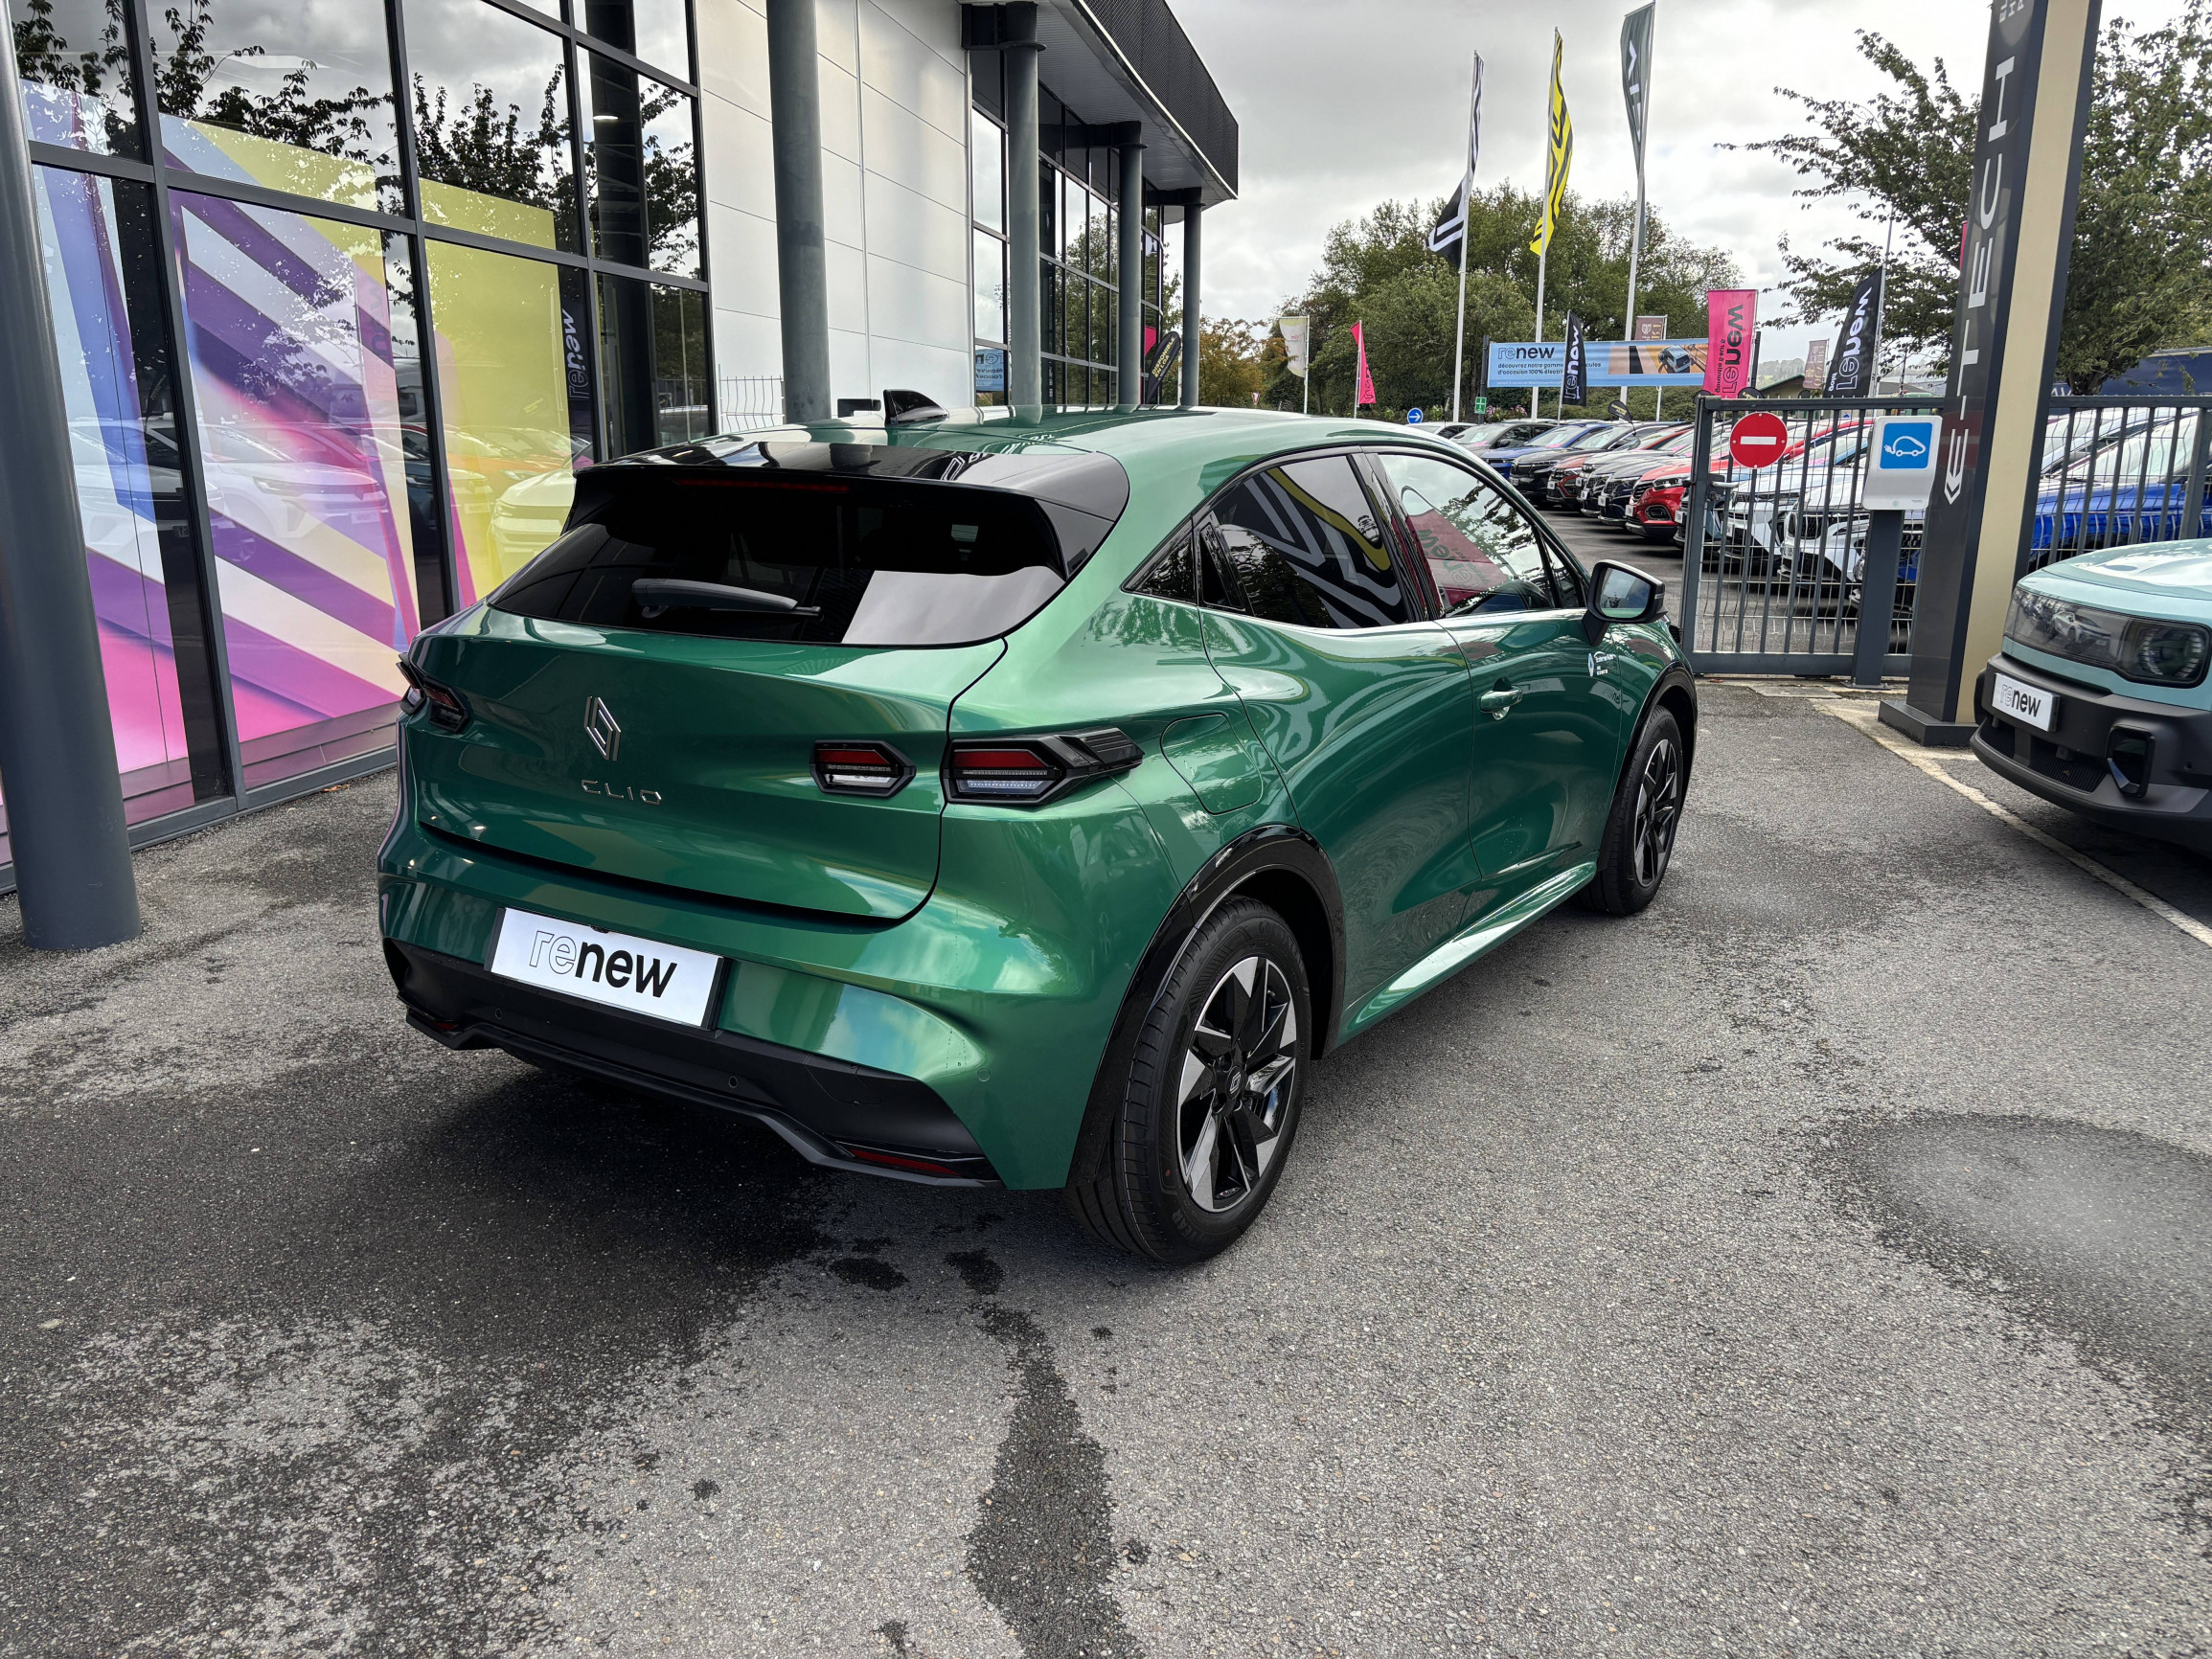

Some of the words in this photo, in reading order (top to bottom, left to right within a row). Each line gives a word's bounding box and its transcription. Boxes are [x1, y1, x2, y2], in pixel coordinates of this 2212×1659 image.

[561, 307, 590, 399] renew
[1152, 336, 1175, 375] DISPONIBLE
[1497, 347, 1555, 360] renew
[1563, 324, 1580, 399] renew
[1999, 683, 2041, 717] renew
[581, 778, 663, 806] CLIO
[529, 930, 678, 998] renew
